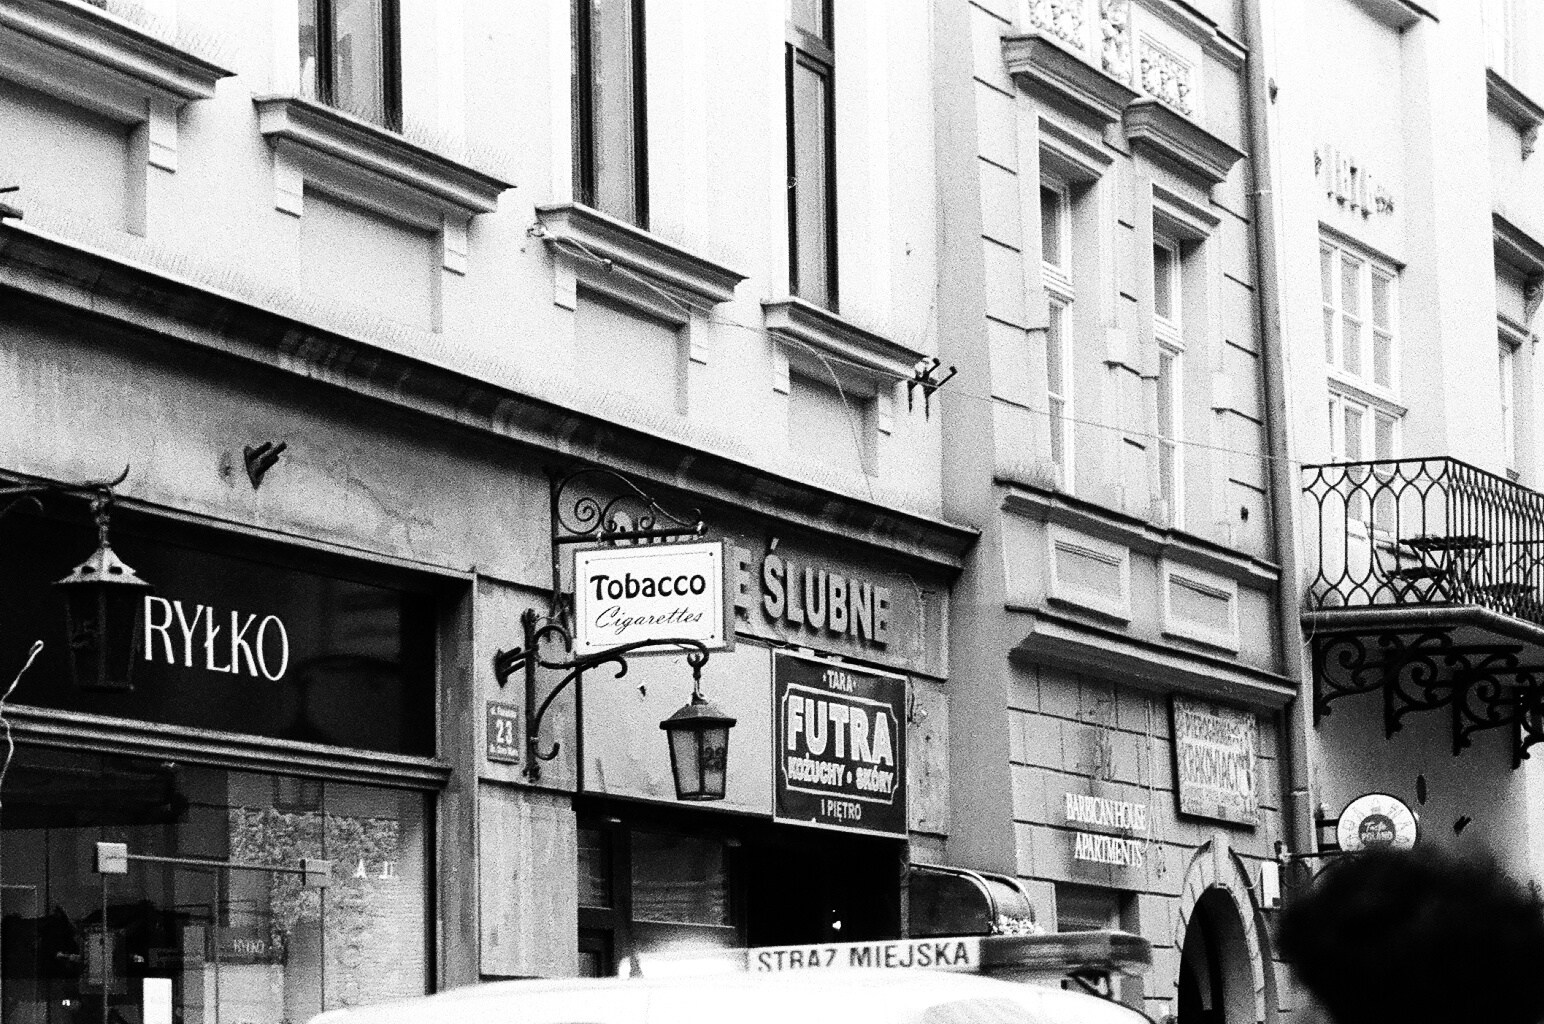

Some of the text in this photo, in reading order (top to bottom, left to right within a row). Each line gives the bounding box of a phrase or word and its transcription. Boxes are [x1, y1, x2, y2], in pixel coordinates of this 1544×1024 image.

[589, 572, 707, 601] Tobacco
[763, 537, 890, 644] ŚLUBNE
[595, 605, 704, 635] Cigarettes
[143, 595, 290, 682] RYŁKO
[826, 669, 855, 693] TARA
[496, 719, 513, 745] 23
[787, 694, 894, 767] FUTRA
[787, 751, 894, 793] KOŻUCHY SKÓRY
[827, 800, 862, 823] PIĘTRO
[1065, 792, 1116, 826] BARBICAN
[1115, 800, 1146, 831] HOUSE
[1074, 831, 1143, 868] APARTMENTS
[849, 941, 971, 968] MIEJSKA
